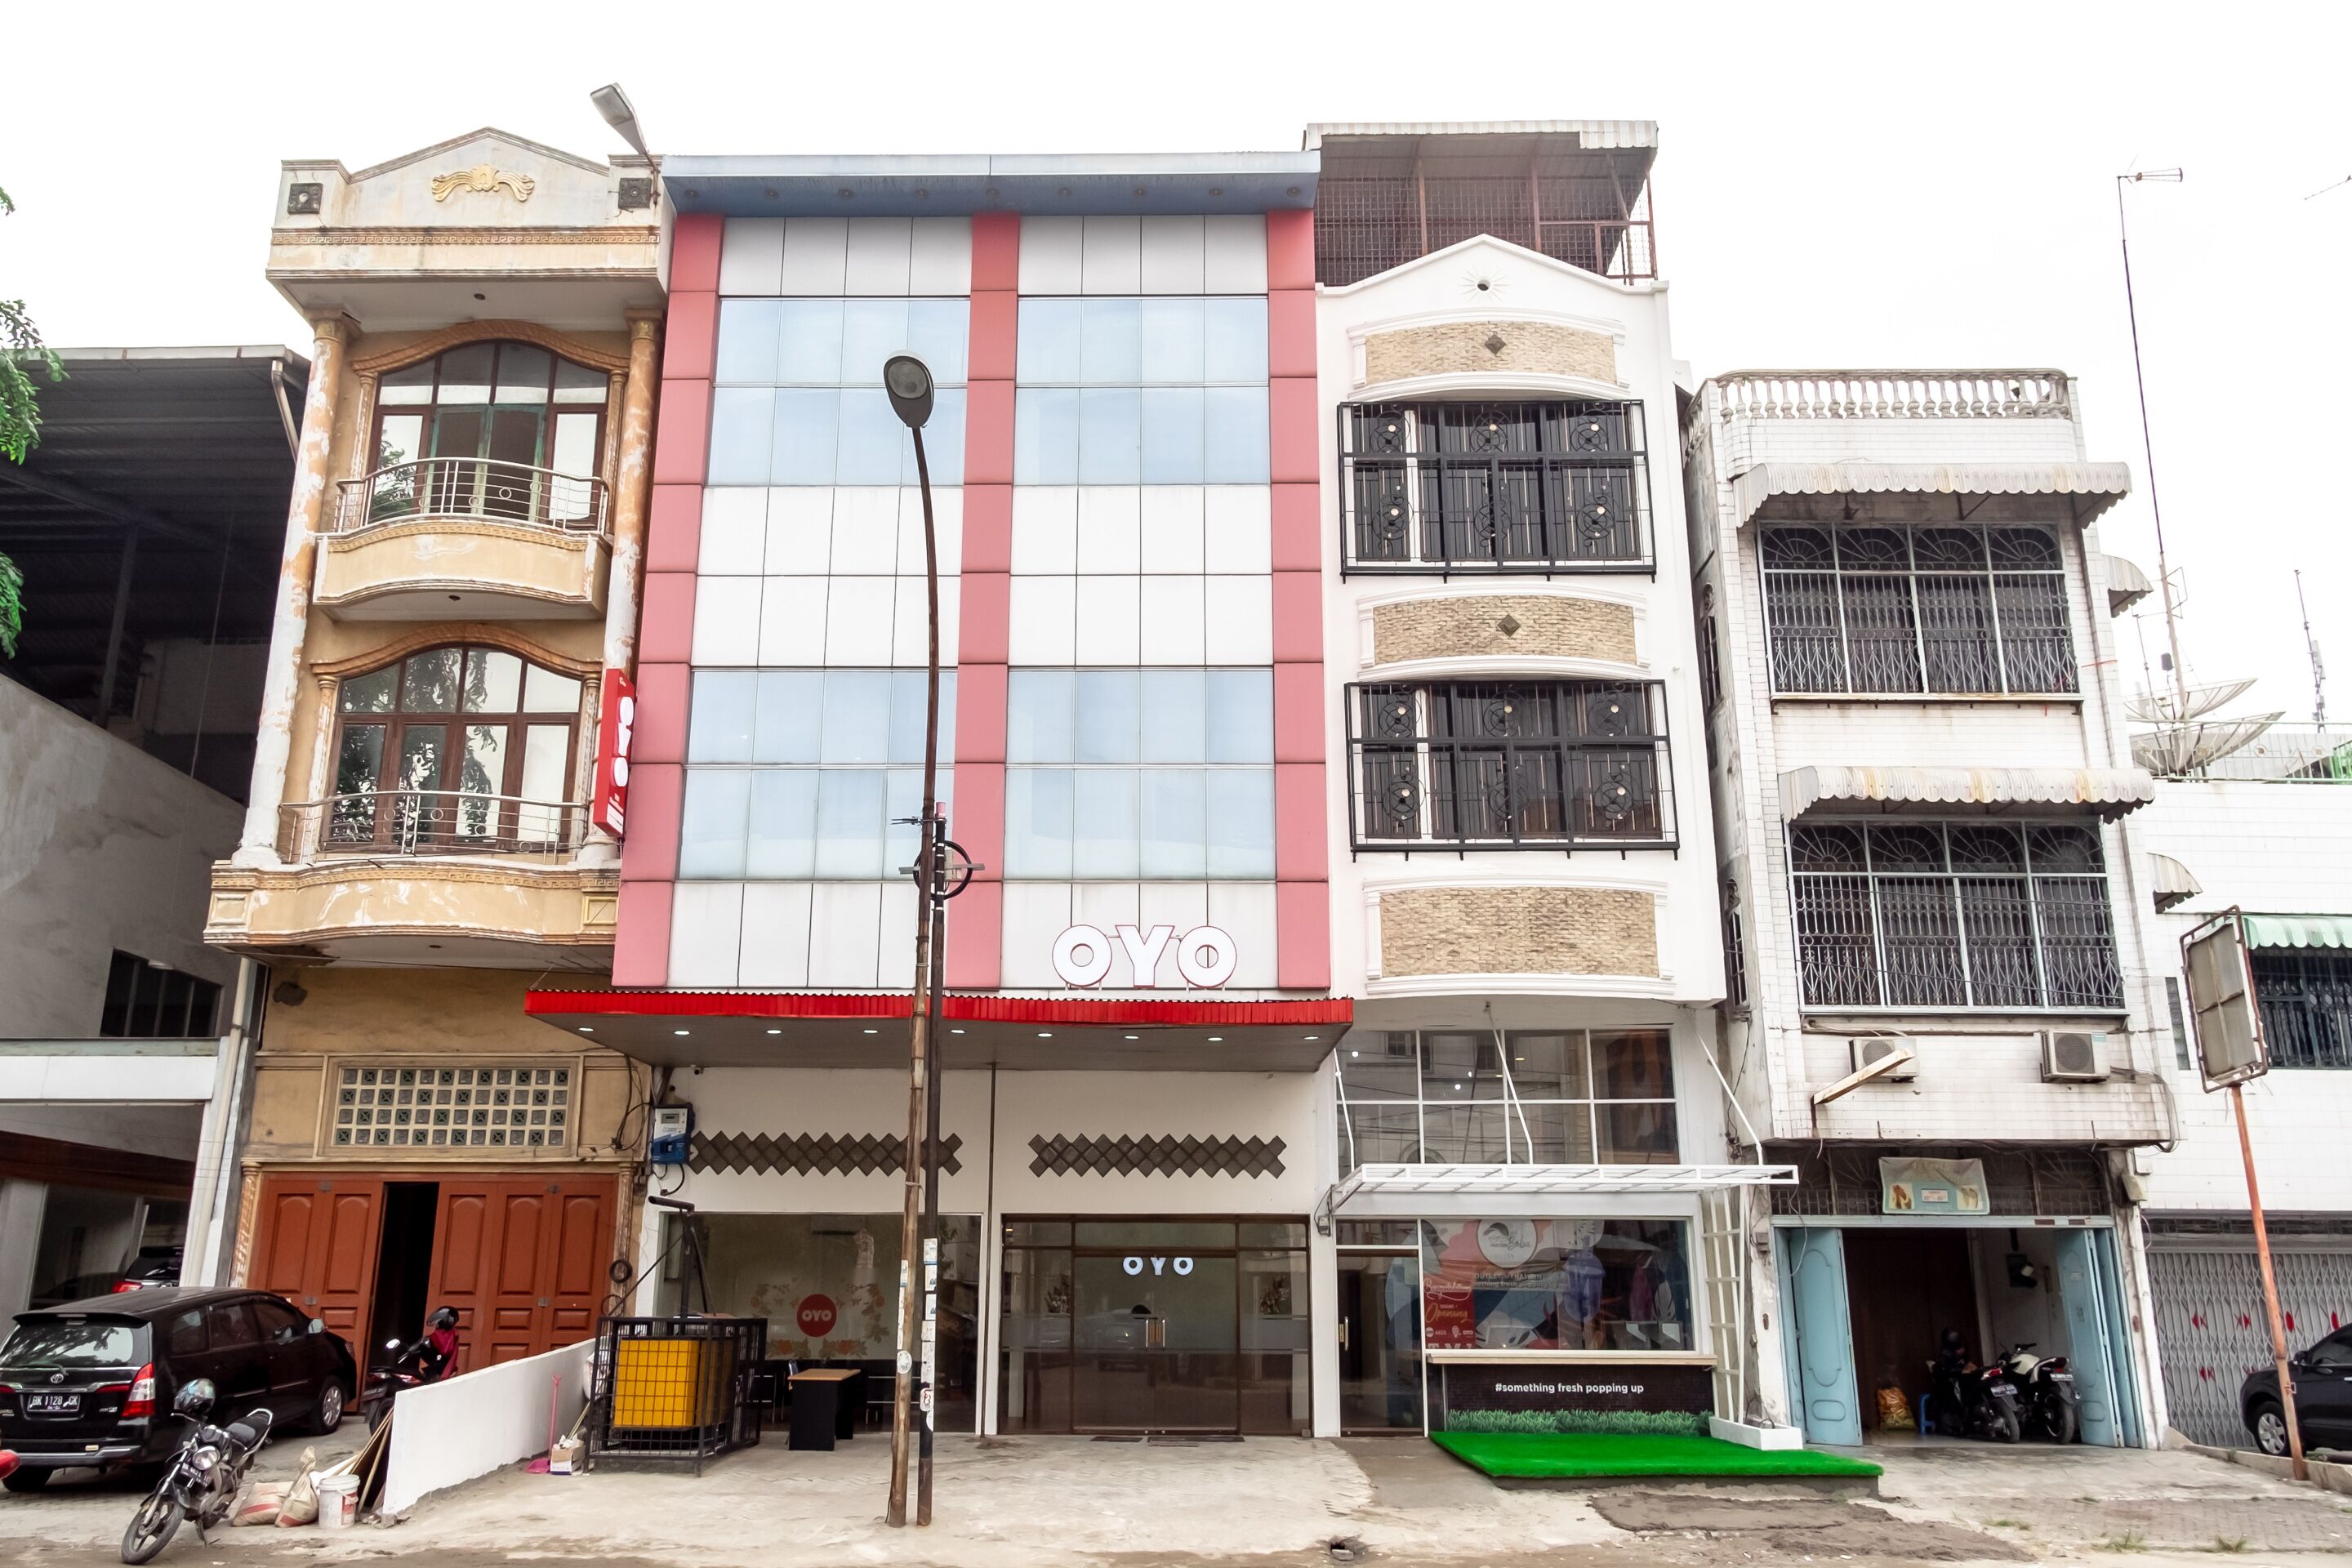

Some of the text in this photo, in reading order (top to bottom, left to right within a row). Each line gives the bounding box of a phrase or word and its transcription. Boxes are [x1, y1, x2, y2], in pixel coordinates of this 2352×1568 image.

[1052, 924, 1237, 988] OYO
[1122, 1257, 1194, 1276] OYO
[801, 1309, 832, 1322] OYO
[1495, 1383, 1644, 1394] #something fresh popping up
